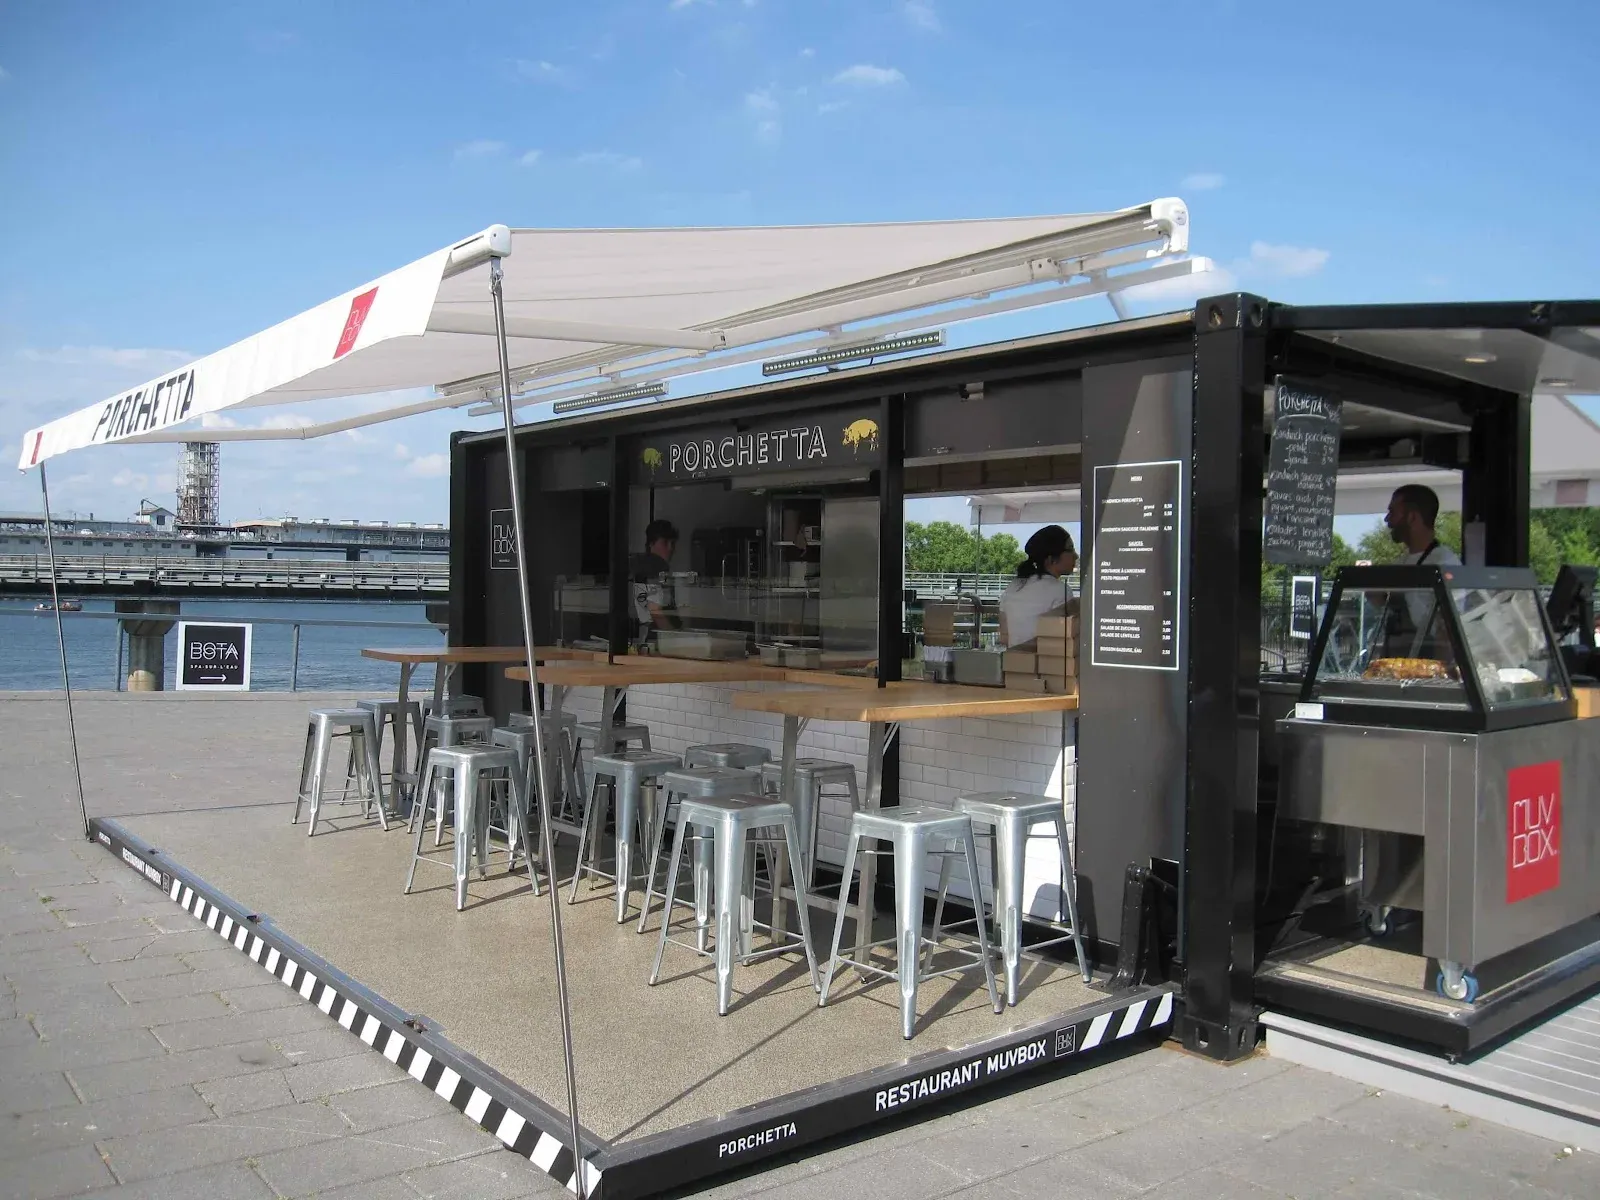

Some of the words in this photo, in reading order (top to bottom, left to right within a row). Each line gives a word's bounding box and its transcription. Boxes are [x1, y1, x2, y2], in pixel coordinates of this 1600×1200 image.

[91, 369, 195, 441] PORCHETTA
[1278, 385, 1322, 414] PORCHETTA
[669, 425, 828, 473] PORCHETTA
[494, 539, 516, 554] BOX
[190, 641, 239, 660] BOTA
[1513, 792, 1555, 834] MUV
[875, 1060, 982, 1112] RESTAURANT
[986, 1039, 1047, 1073] MUVBOX
[719, 1122, 797, 1158] PORCHETTA
